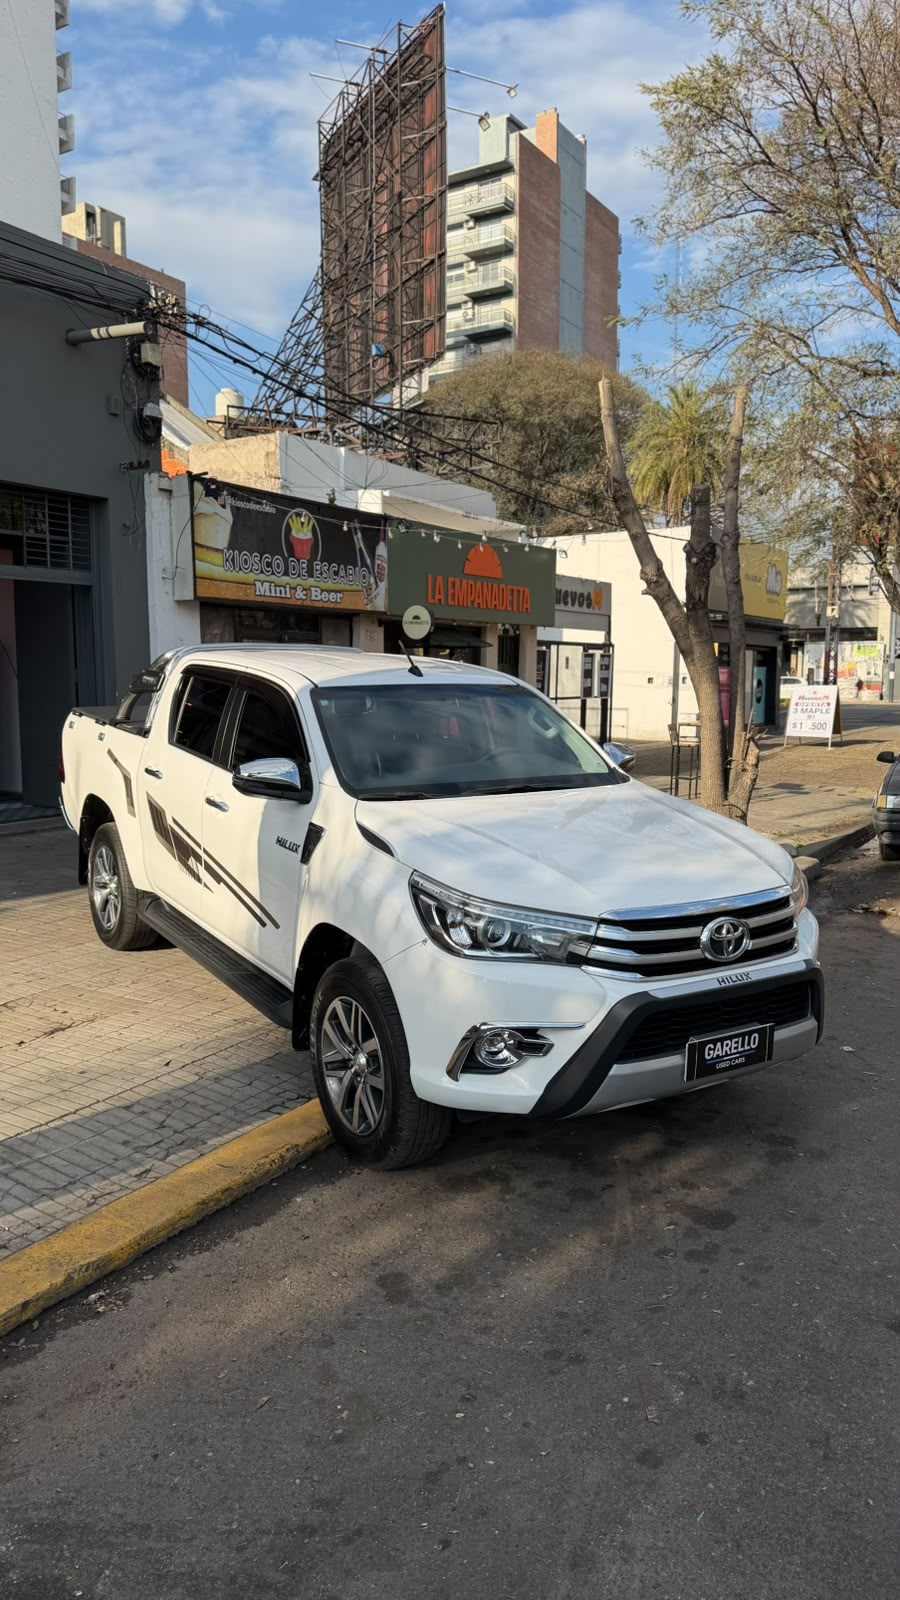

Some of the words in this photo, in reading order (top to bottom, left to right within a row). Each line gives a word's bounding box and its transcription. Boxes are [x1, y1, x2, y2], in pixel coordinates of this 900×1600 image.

[223, 549, 284, 577] KIOSCO
[288, 559, 309, 579] DE
[313, 561, 369, 586] ESCABIO
[254, 581, 291, 599] Mini
[295, 585, 308, 601] &
[310, 587, 343, 604] Beer
[427, 574, 445, 607] LA
[447, 576, 531, 615] EMPANADETTA
[276, 836, 301, 854] HILUX
[716, 972, 753, 986] HILUX
[704, 1033, 759, 1060] GARELLO
[731, 1057, 746, 1066] CARS
